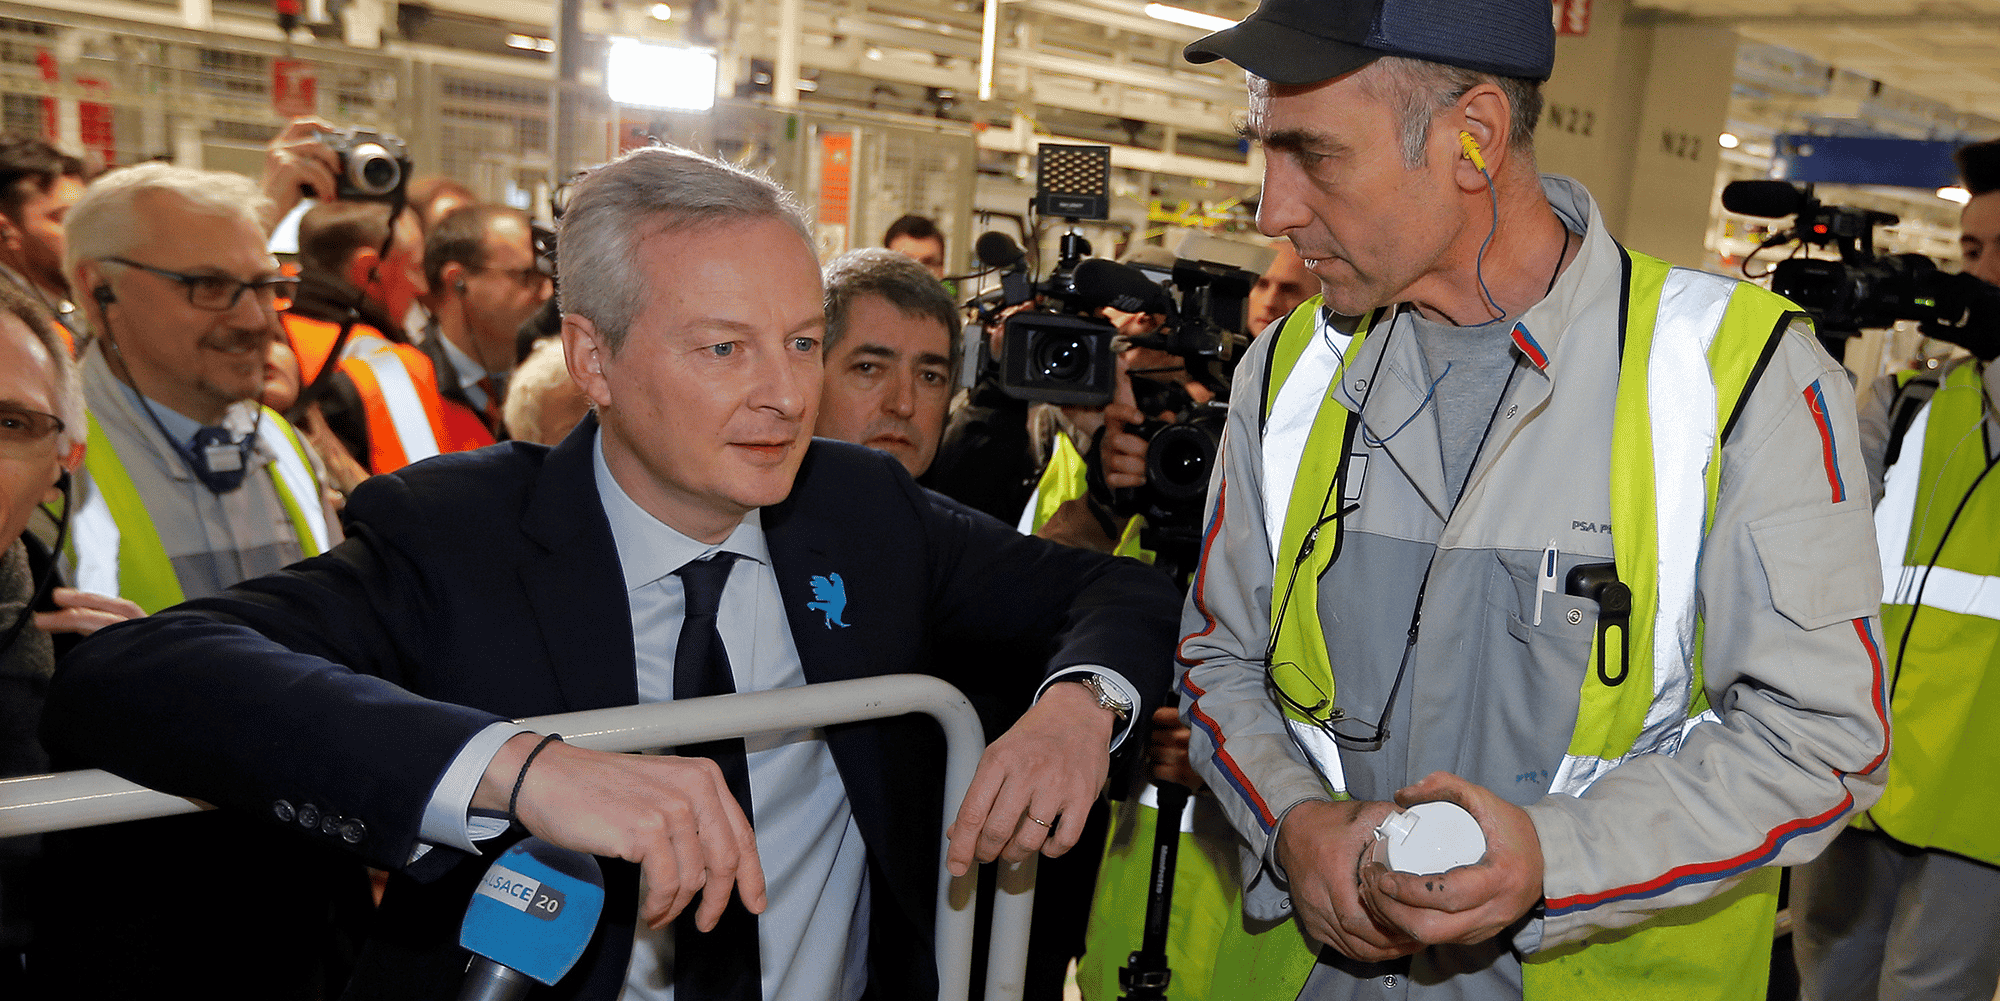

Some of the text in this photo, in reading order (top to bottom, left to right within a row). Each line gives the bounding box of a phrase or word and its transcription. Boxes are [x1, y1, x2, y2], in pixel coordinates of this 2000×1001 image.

[1549, 104, 1594, 137] N22
[1661, 129, 1701, 161] N22
[1572, 520, 1597, 533] PSA
[535, 894, 559, 913] 20
